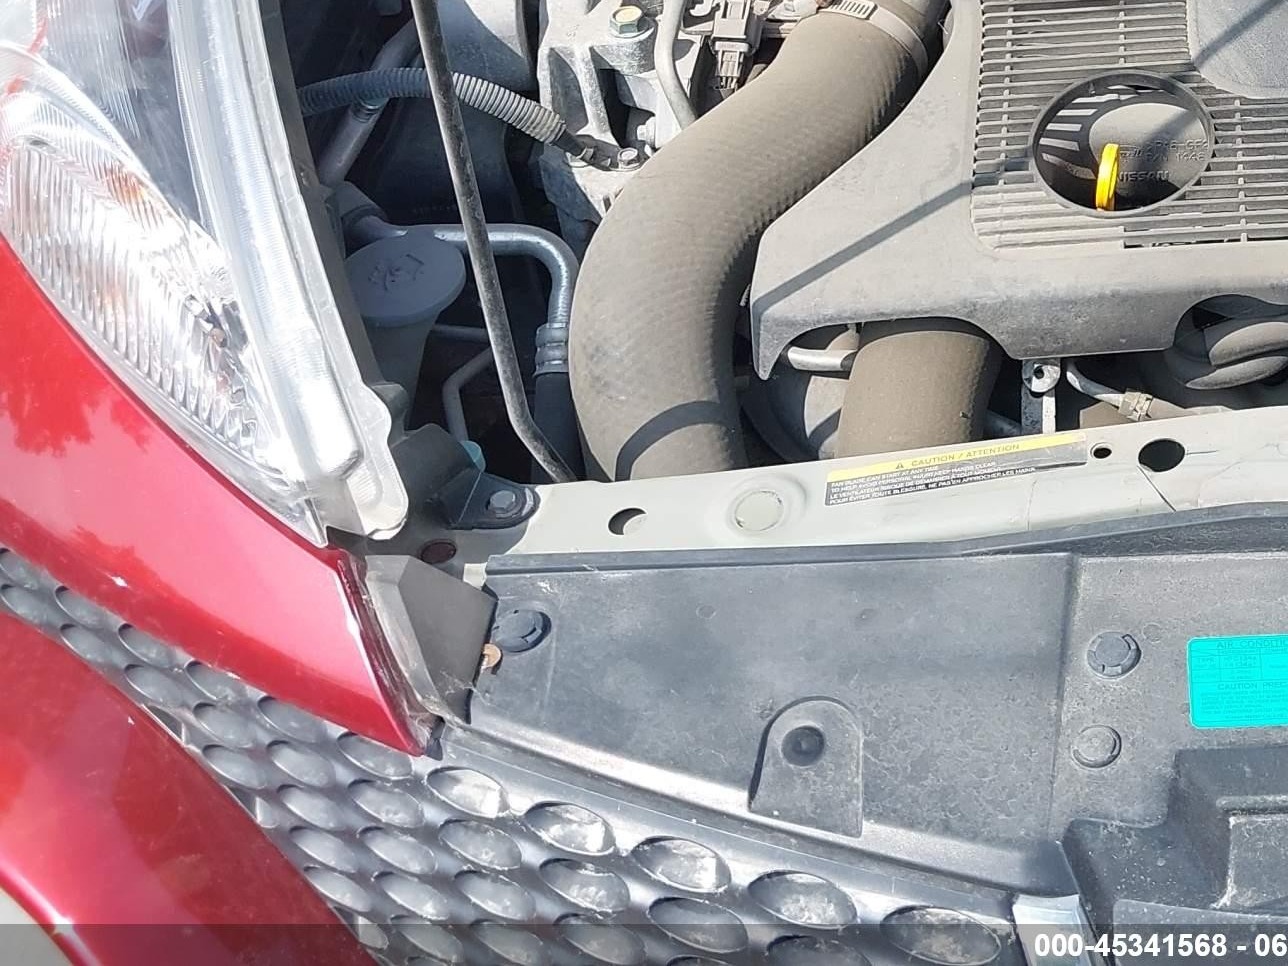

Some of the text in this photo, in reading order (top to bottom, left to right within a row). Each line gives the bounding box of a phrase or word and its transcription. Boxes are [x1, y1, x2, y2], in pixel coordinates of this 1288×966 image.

[912, 455, 955, 466] CAUTION
[966, 444, 1020, 457] ATTENTION
[1216, 641, 1234, 649] AIR
[1217, 681, 1258, 691] CAUTION
